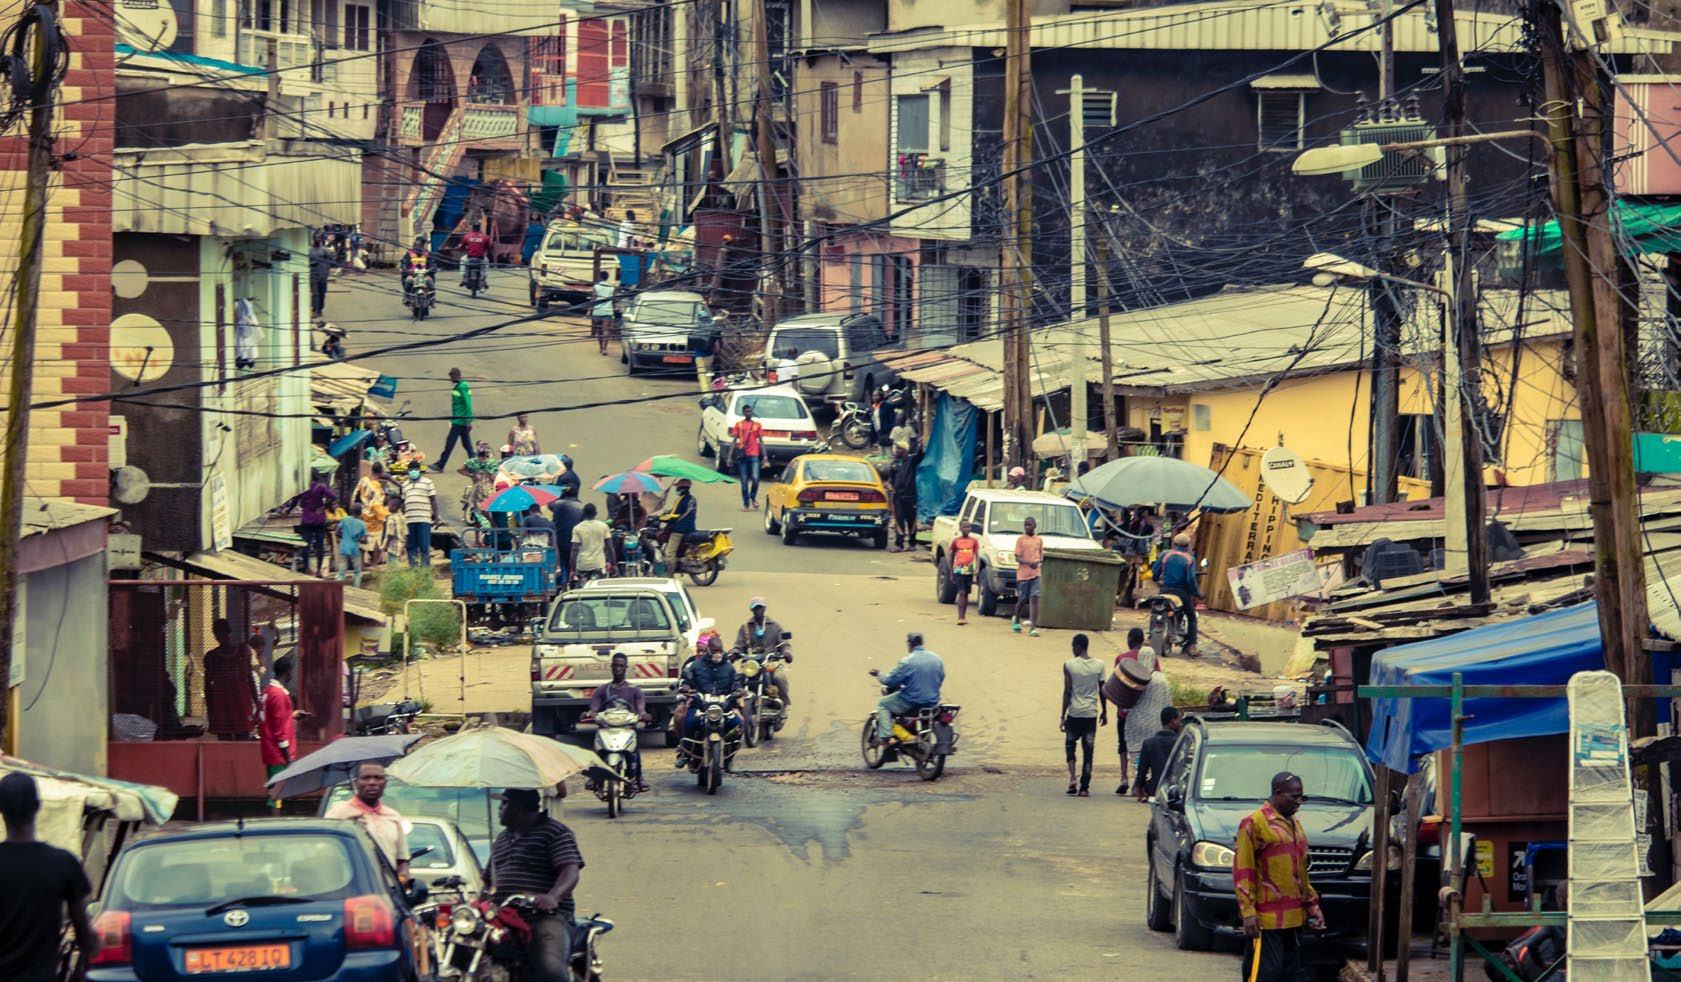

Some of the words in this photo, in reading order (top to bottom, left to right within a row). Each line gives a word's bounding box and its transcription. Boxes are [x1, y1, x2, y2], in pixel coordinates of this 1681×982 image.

[1243, 473, 1265, 564] MEDITERRA
[1261, 495, 1279, 560] HIPPIN
[1512, 872, 1527, 881] Ora
[200, 952, 222, 969] LT
[227, 949, 257, 968] 428
